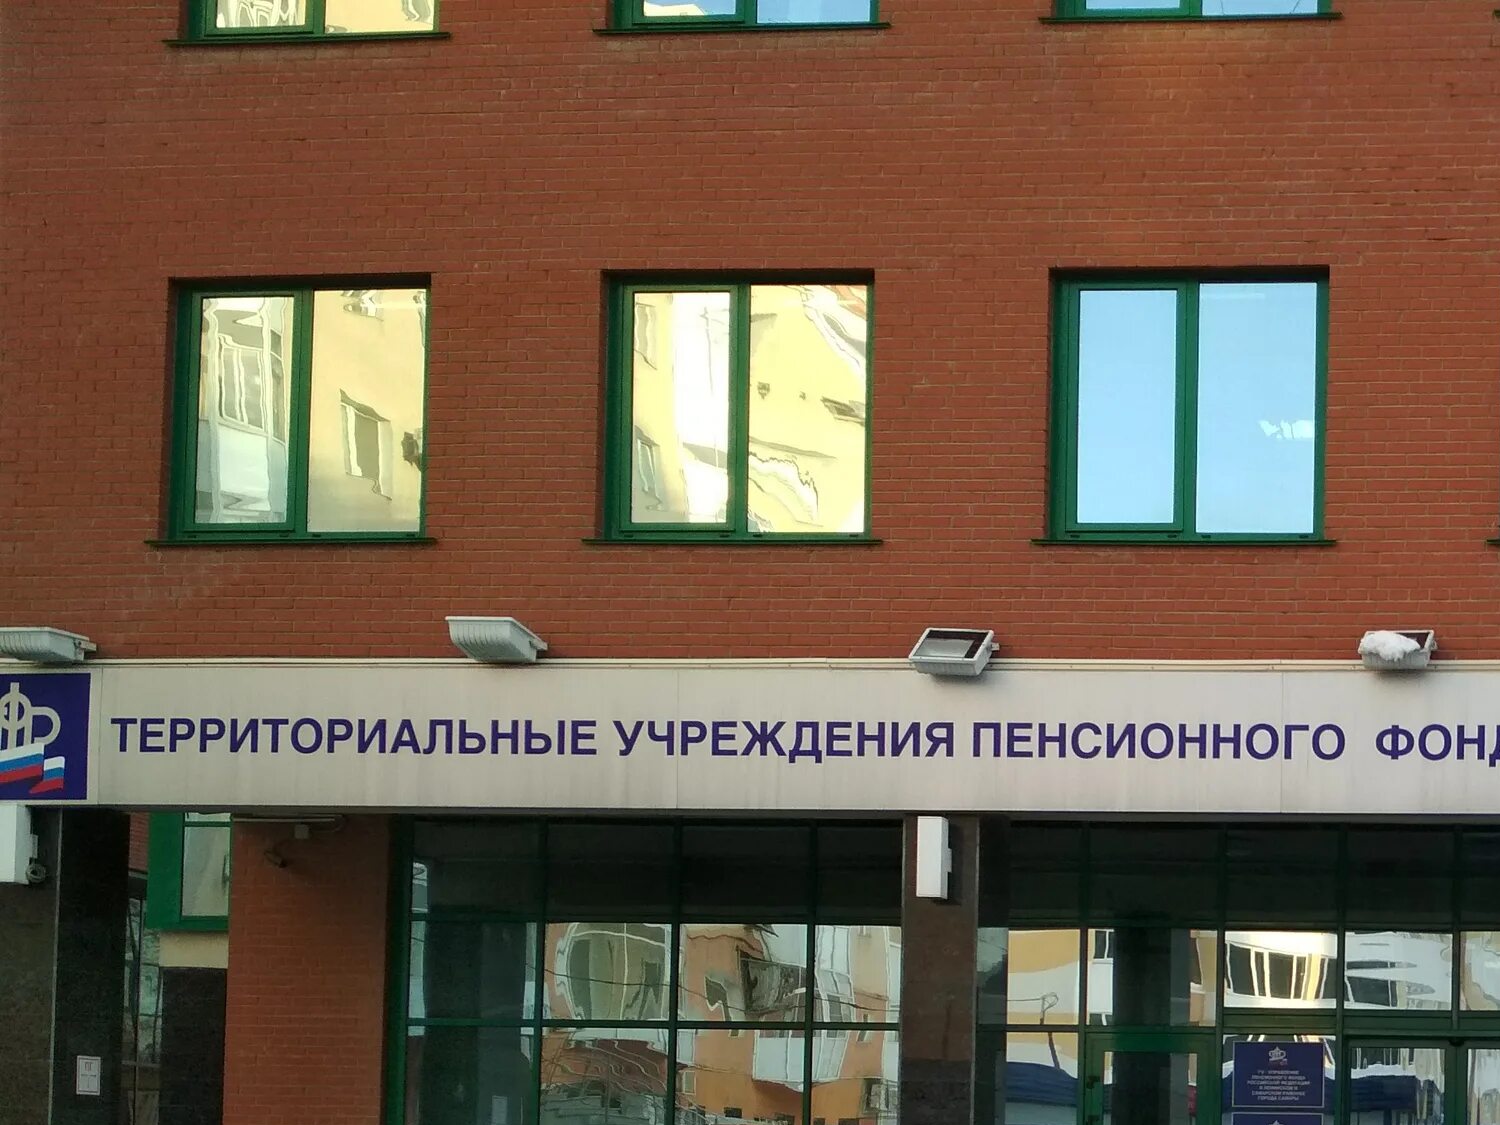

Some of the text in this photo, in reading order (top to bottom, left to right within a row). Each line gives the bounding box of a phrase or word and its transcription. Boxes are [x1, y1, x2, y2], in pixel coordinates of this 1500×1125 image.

[111, 717, 596, 755] ТЕРРИТОРИАЛЬНЫЕ
[615, 720, 953, 763] УЧРЕЖДЕНИЯ
[973, 722, 1345, 760] ПЕНСИОННОГО
